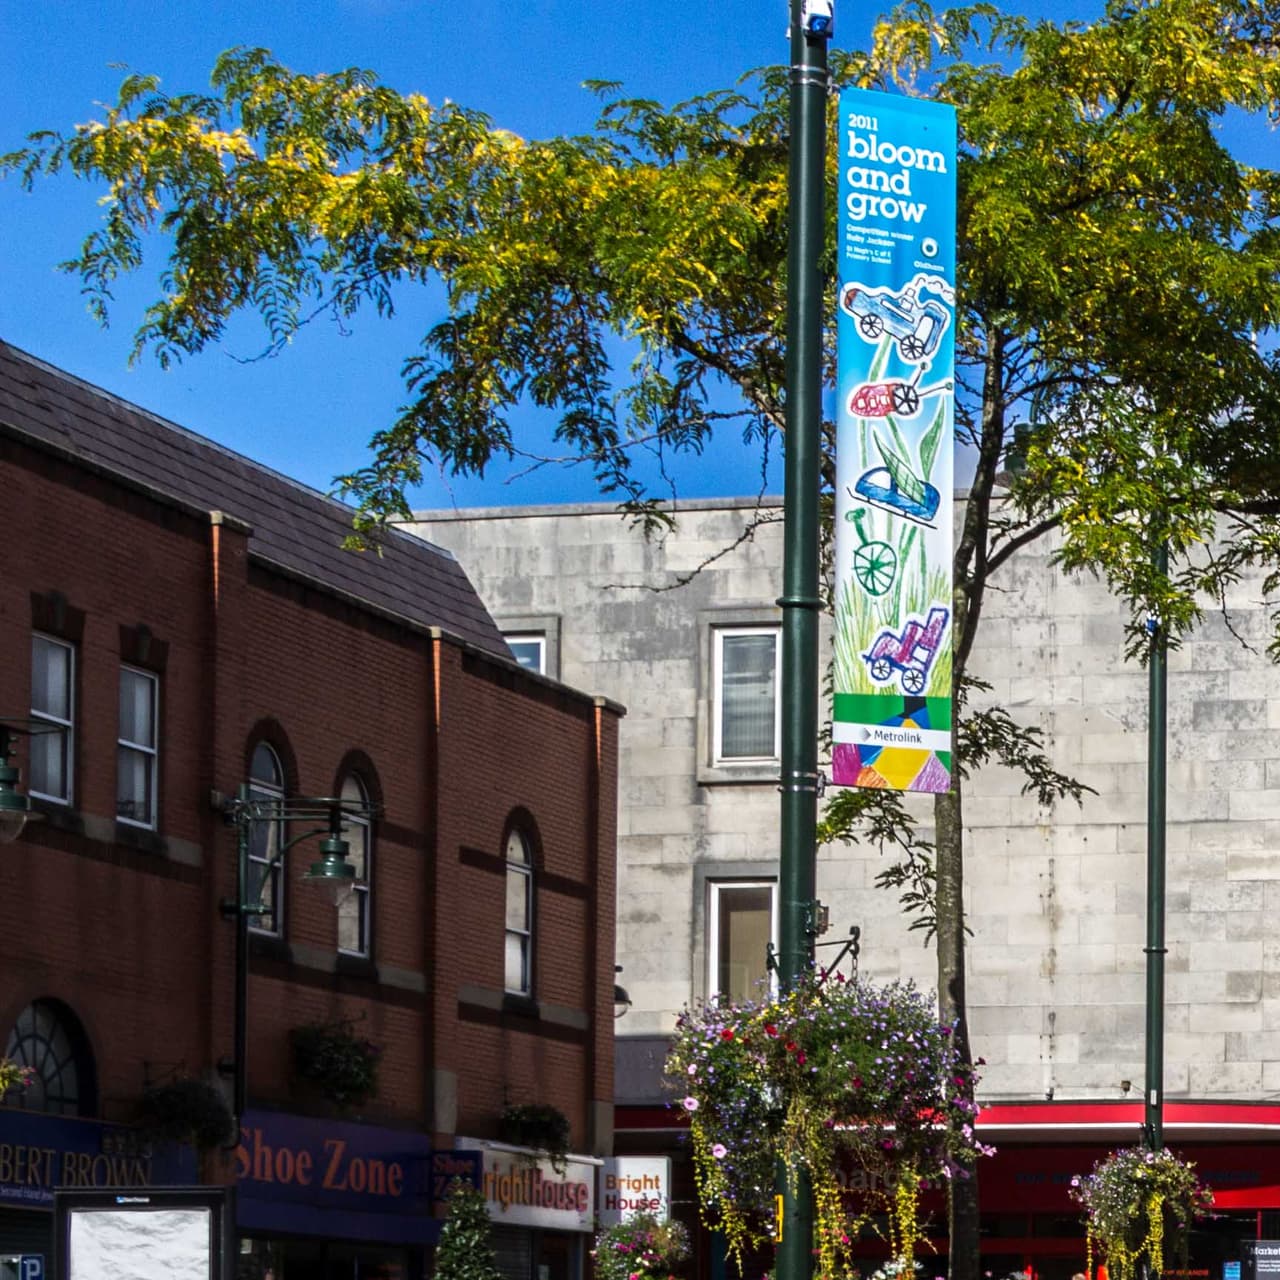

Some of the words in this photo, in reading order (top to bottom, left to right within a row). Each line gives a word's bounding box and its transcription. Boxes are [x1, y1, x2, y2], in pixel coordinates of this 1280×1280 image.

[848, 113, 879, 131] 2011
[847, 130, 947, 174] bloom
[847, 166, 912, 196] and
[846, 192, 927, 223] grow
[874, 730, 922, 743] Metrolink
[64, 1151, 150, 1187] BROWN
[322, 1139, 403, 1196] Zone
[483, 1162, 589, 1212] rightHouse
[605, 1173, 661, 1193] Bright
[605, 1194, 661, 1211] House
